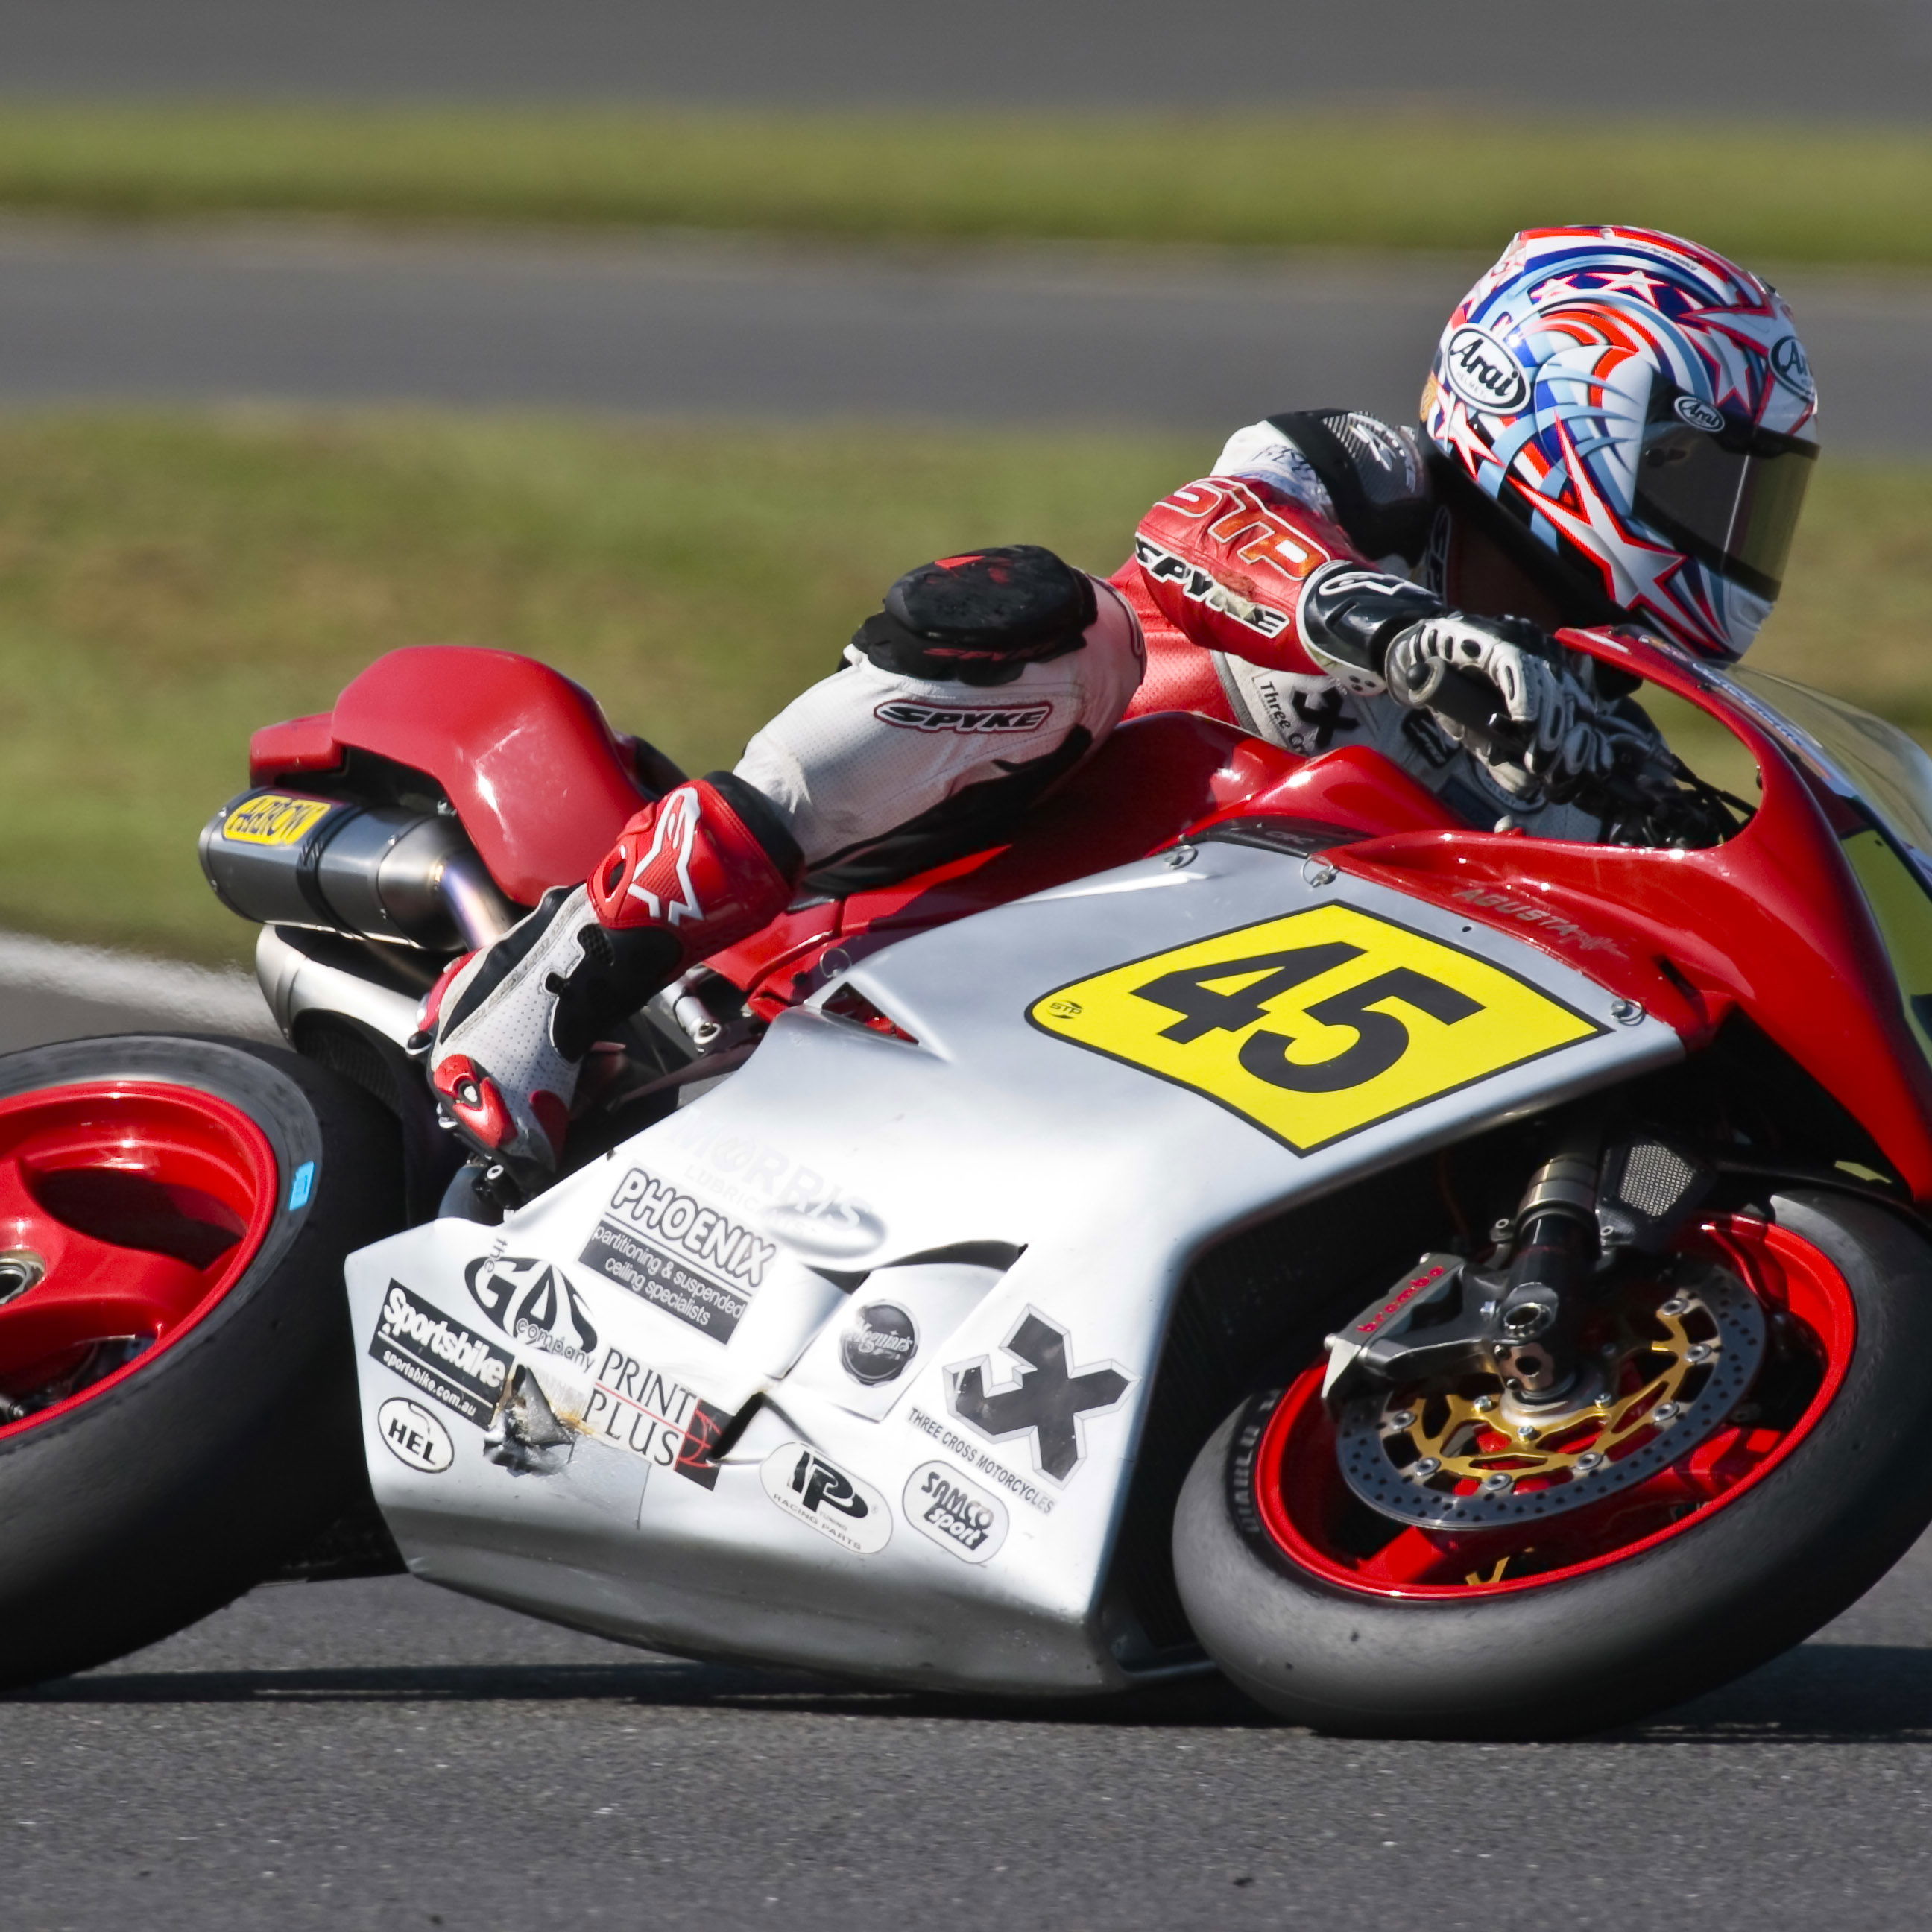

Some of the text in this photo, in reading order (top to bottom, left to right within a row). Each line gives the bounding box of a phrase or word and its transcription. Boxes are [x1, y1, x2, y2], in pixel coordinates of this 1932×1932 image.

[1449, 338, 1518, 396] Arai
[1682, 403, 1717, 426] Arai
[1153, 477, 1331, 581] STP
[880, 704, 1048, 730] SPYKE
[1260, 681, 1291, 729] Three
[1453, 888, 1579, 936] AGUSTA
[1128, 941, 1486, 1093] 45
[666, 1108, 872, 1228] MORRIS
[610, 1167, 777, 1287] PHOENIX
[592, 1225, 747, 1319] partitioning & suspended
[604, 1257, 710, 1325] ceiling specialists
[1356, 1266, 1445, 1333] brembo
[383, 1287, 506, 1388] Sportsbike
[516, 1318, 596, 1374] company
[382, 1350, 477, 1416] sportsbike.com.au
[598, 1347, 698, 1424] PRINT
[388, 1417, 436, 1465] HEL
[581, 1388, 680, 1467] PLUS
[907, 1407, 1056, 1515] THREE CROSS MOTORCYCLES
[773, 1492, 862, 1551] RACING PARTS
[921, 1471, 995, 1530] SAMCO
